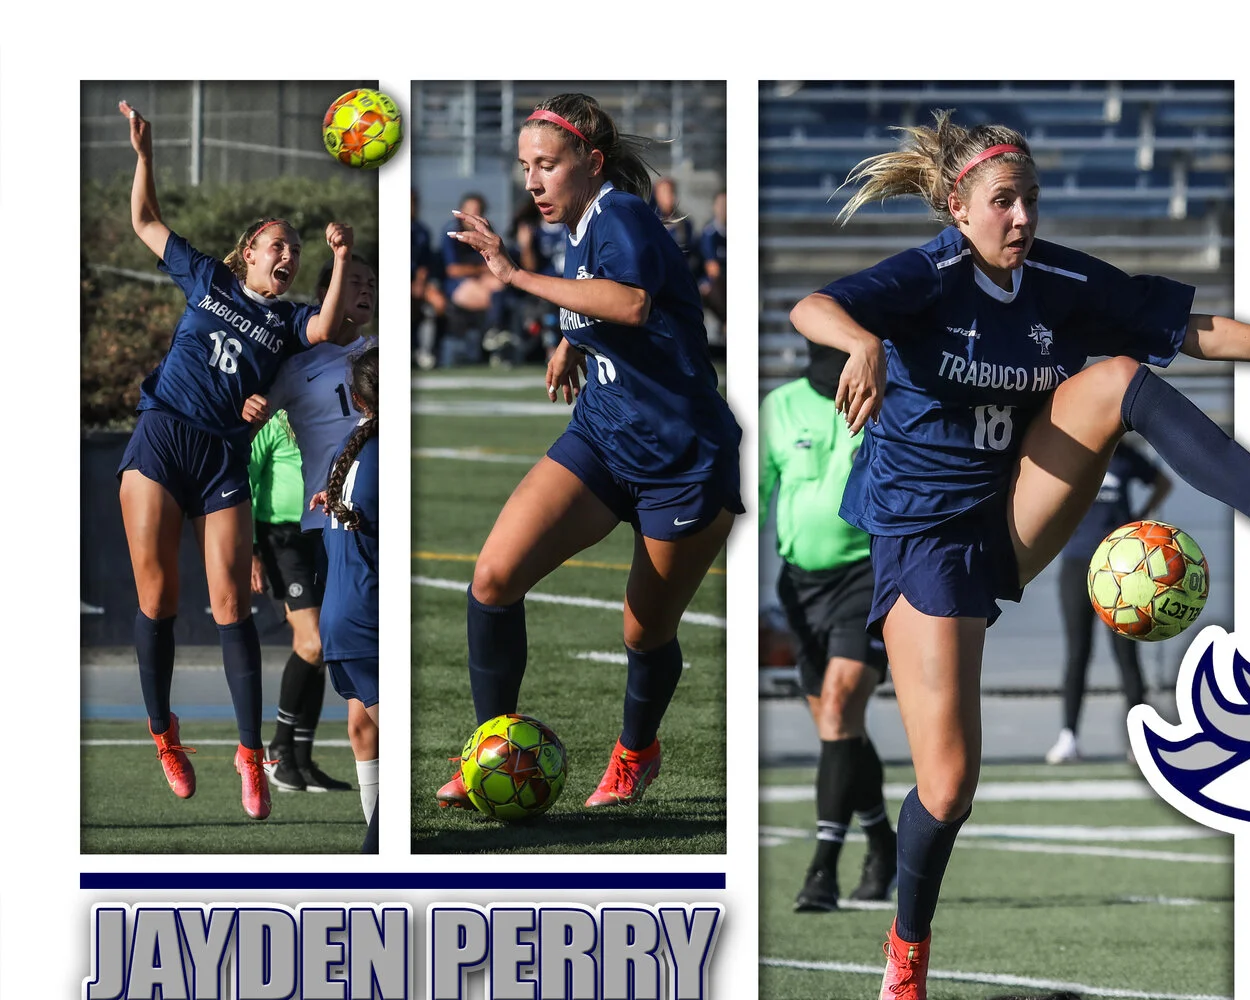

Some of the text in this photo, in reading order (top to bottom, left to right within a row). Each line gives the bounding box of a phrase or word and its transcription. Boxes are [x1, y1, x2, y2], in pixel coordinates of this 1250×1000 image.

[208, 330, 243, 374] 18
[249, 325, 284, 354] HILLS
[938, 351, 1028, 391] TRABUCO
[969, 404, 1017, 450] 18
